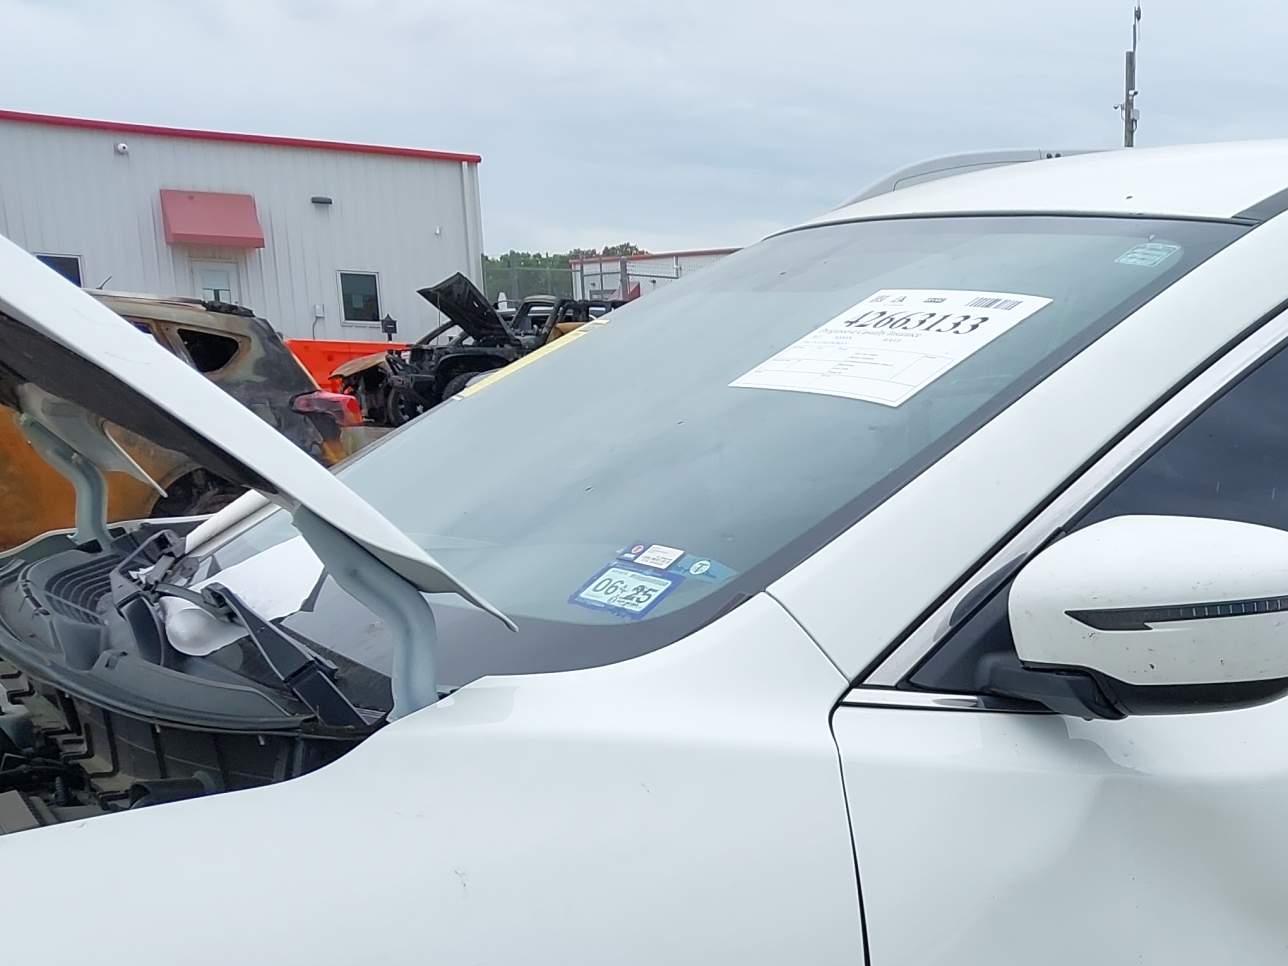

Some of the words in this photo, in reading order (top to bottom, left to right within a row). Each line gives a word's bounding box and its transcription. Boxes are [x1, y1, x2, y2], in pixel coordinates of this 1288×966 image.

[843, 310, 990, 335] 42663133
[592, 577, 625, 596] 06
[623, 584, 659, 604] 25
